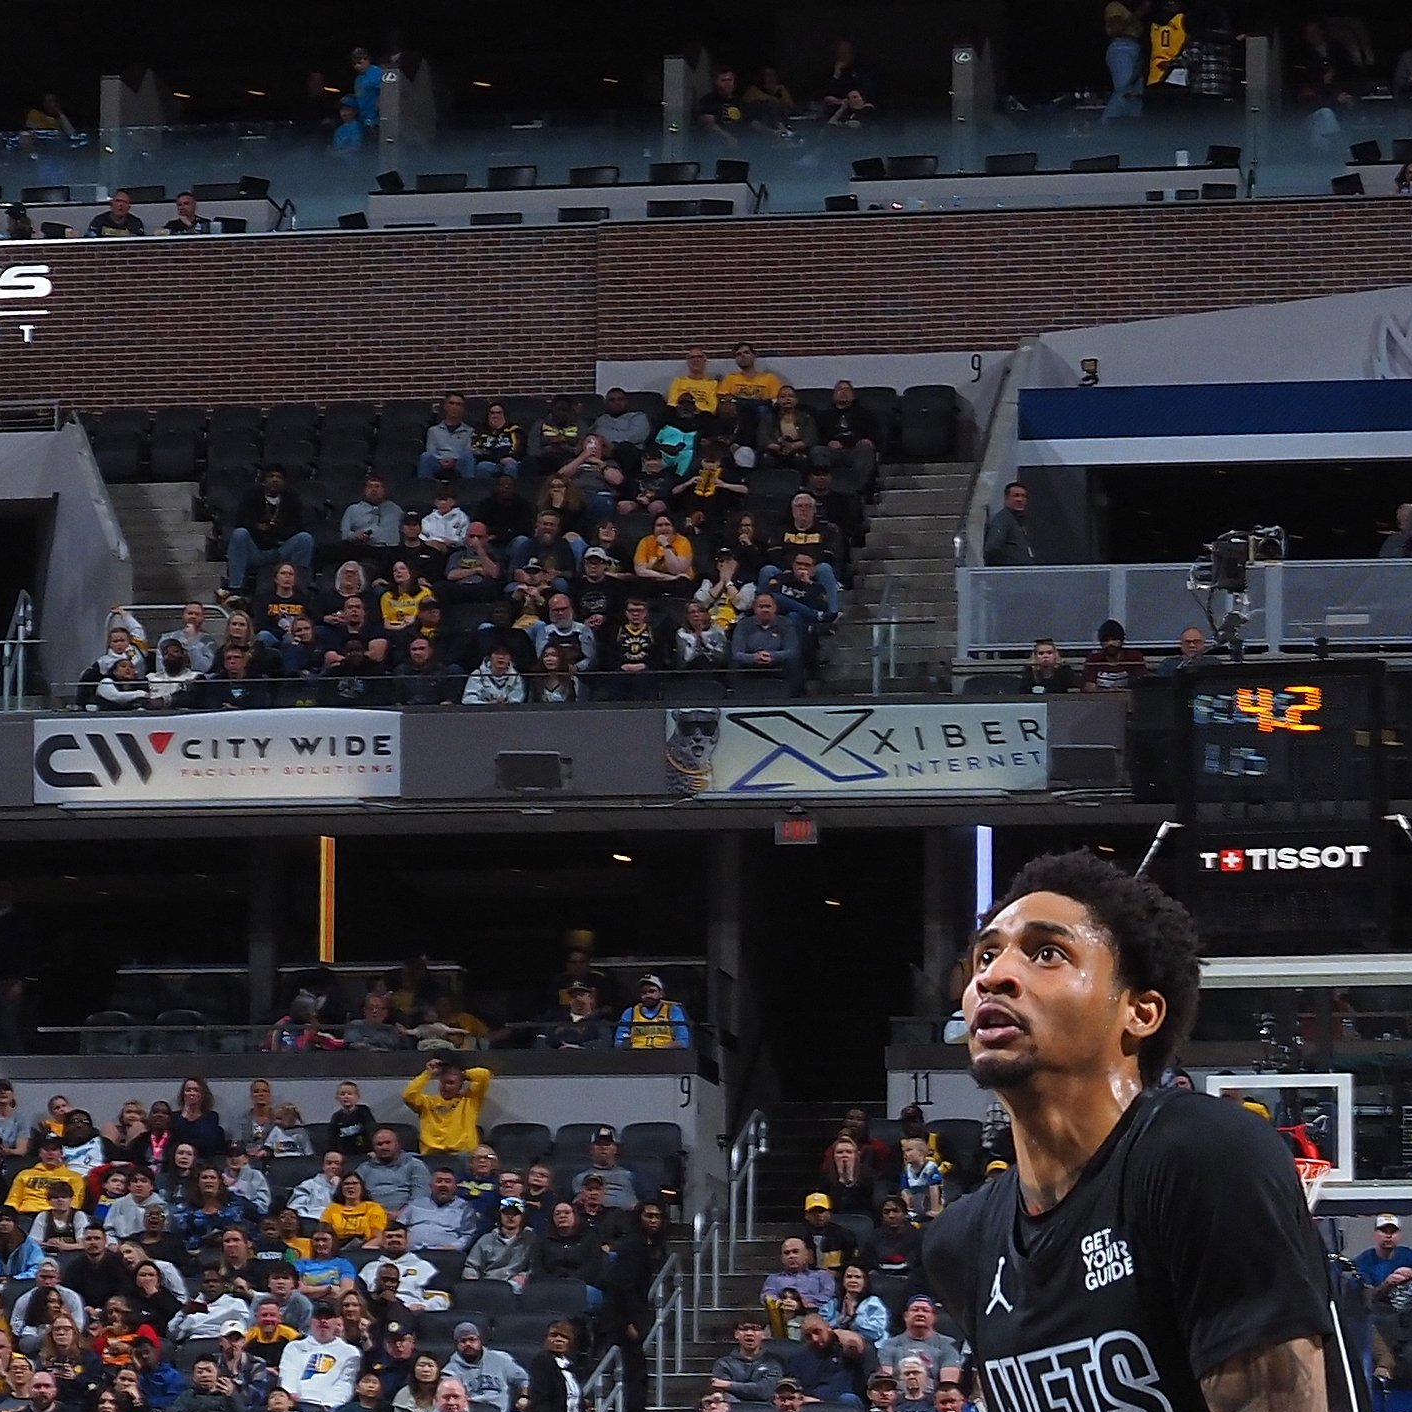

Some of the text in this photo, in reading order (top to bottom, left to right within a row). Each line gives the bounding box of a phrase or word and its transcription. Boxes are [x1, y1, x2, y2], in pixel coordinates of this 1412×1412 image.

[971, 353, 982, 384] 9
[181, 735, 392, 760] CITY WIDE
[869, 719, 1045, 755] XIBER
[180, 763, 394, 778] FACILITY SOLUTIONS
[894, 751, 1042, 779] INTERNET
[1246, 845, 1370, 871] TISSOT
[679, 1076, 692, 1108] 9
[910, 1072, 935, 1106] 11
[1080, 1228, 1113, 1255] GET
[1082, 1239, 1130, 1275] YOUR
[1084, 1257, 1134, 1292] GUIDE
